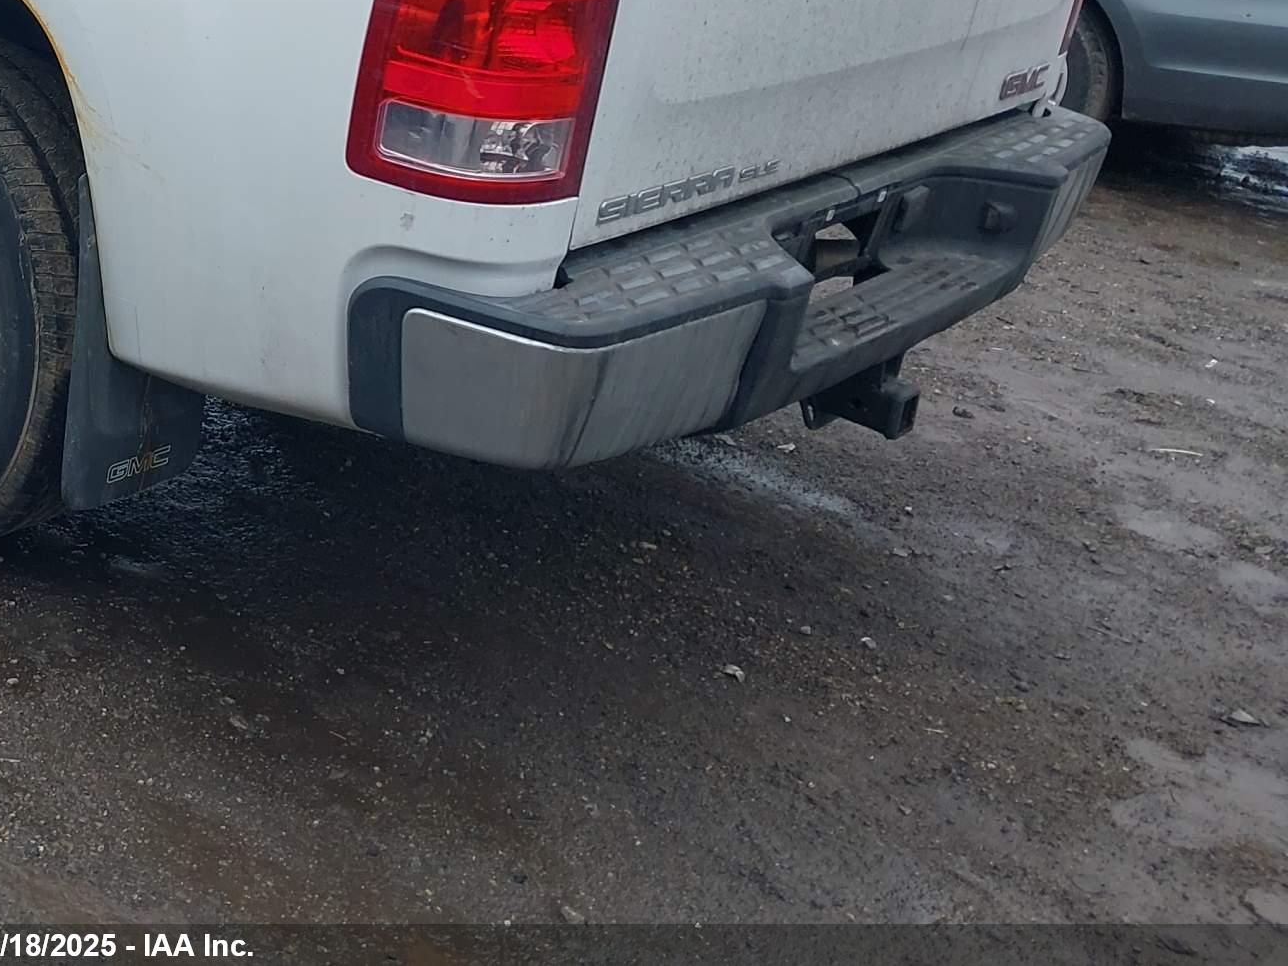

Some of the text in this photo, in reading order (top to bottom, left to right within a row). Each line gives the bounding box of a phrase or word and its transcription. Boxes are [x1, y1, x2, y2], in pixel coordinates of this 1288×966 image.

[998, 62, 1051, 101] GMC
[596, 158, 781, 225] SIERRA SLE
[106, 444, 172, 484] GMC
